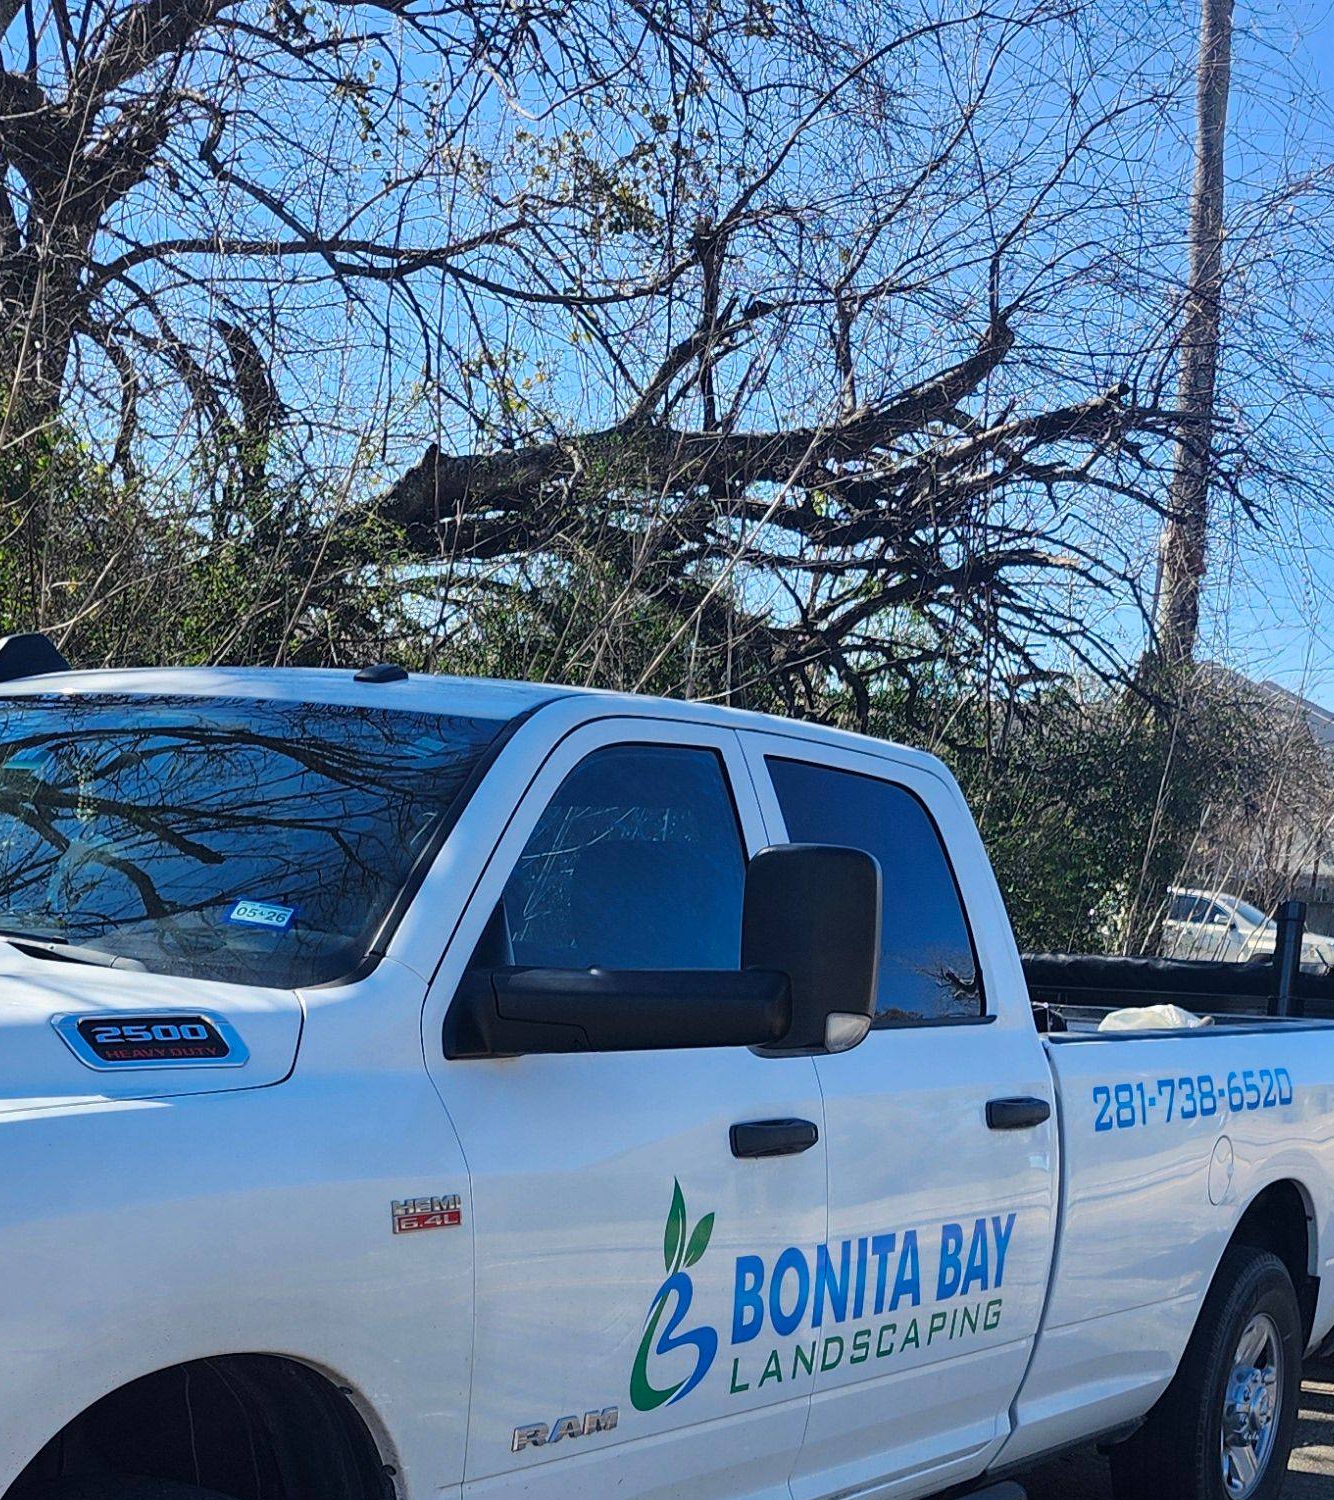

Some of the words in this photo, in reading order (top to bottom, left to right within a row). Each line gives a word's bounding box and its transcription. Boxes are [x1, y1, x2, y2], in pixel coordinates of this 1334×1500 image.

[236, 906, 258, 918] 05
[264, 910, 288, 923] 26
[91, 1024, 208, 1043] 2500
[105, 1048, 166, 1060] HEAVY
[170, 1047, 217, 1058] DUTY
[1092, 1068, 1293, 1132] 281-738-6520
[391, 1194, 462, 1216] HEMI
[400, 1214, 459, 1230] 6.4L
[731, 1229, 921, 1345] BONITA
[936, 1213, 1017, 1301] BAY
[729, 1299, 1003, 1394] LANDSCAPING
[511, 1406, 619, 1453] RAM
